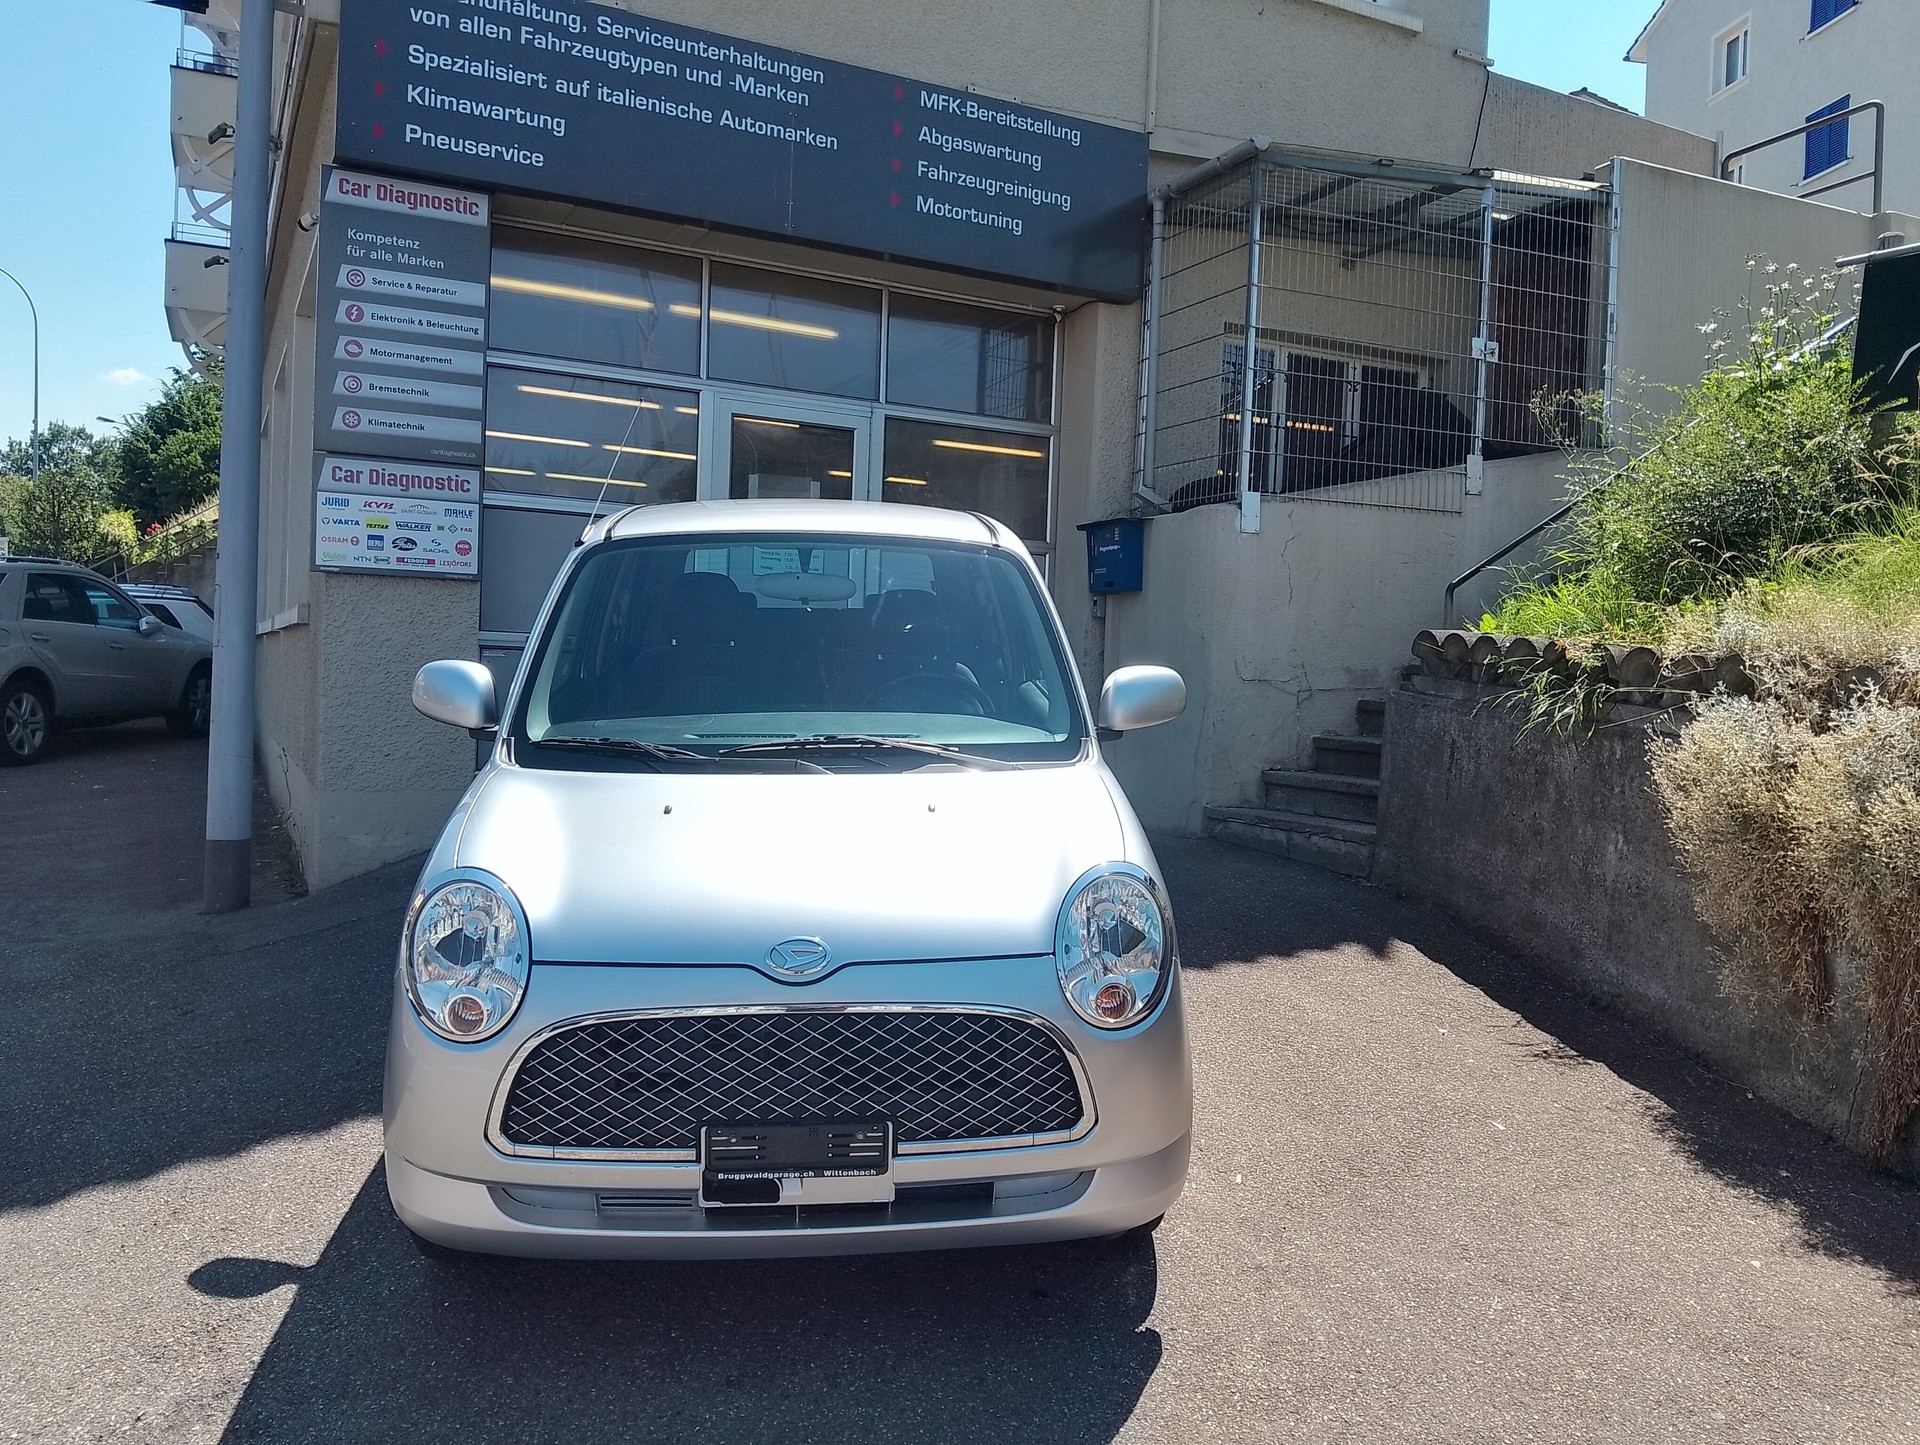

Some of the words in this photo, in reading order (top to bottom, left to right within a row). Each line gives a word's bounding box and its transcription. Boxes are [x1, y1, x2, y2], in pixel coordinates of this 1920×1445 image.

[410, 7, 449, 29] von
[459, 16, 512, 41] allen
[520, 26, 678, 77] Fahrzeugtypen
[685, 67, 722, 87] und
[729, 74, 809, 106] -Marken
[597, 15, 824, 83] Serviceunterhaltungen
[408, 44, 548, 90] Spezialisiert
[555, 79, 590, 98] auf
[597, 83, 713, 123] italienische
[719, 109, 838, 150] Automarken
[407, 83, 566, 136] Klimawartung
[920, 90, 1081, 146] MFK-Bereitstellung
[405, 123, 544, 168] Pneuservice
[918, 126, 1042, 171] Abgaswartung
[917, 160, 1071, 211] Fahrzeugreinigung
[338, 177, 371, 198] Car
[376, 184, 480, 217] Diagnostic
[916, 195, 1023, 235] Motortuning
[347, 228, 420, 249] Kompetenz
[346, 245, 366, 258] für
[370, 249, 393, 262] alle
[397, 252, 445, 270] Marken
[371, 277, 405, 289] Service
[415, 284, 458, 297] Reparatur
[371, 312, 416, 326] Elektronik
[426, 319, 480, 335] Beleuchtung
[369, 348, 453, 365] Motormanagement
[368, 383, 430, 397] Bremstechnik
[367, 418, 426, 432] Klimatechnik
[331, 465, 364, 485] Car
[368, 468, 471, 493] Diagnostic
[322, 497, 350, 507] JURID
[363, 501, 395, 510] KYB
[444, 508, 473, 517] MAHLE
[332, 518, 360, 526] VARTA
[396, 521, 432, 532] WALKER
[321, 536, 348, 544] OSRAM
[440, 560, 472, 568] LESJÖFORS
[718, 1170, 814, 1180] Bruggwaldgarage.ch
[823, 1168, 876, 1177] Wittenbach
